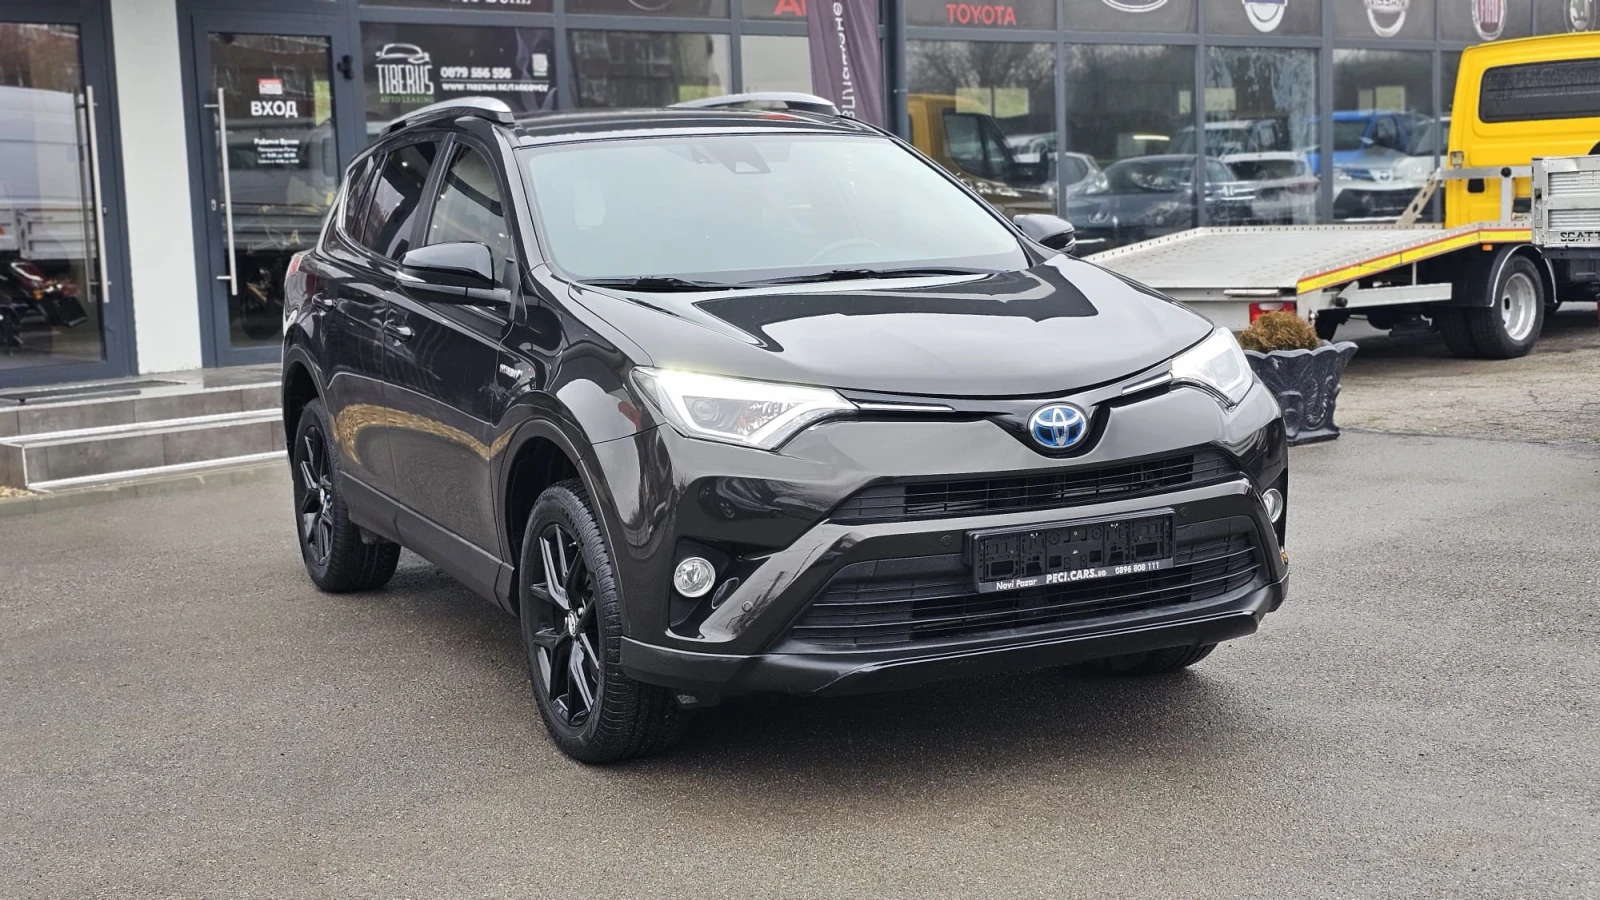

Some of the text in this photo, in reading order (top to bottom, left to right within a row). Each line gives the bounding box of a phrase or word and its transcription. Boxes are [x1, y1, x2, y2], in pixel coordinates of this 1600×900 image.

[946, 3, 1017, 26] TOYOTA
[375, 64, 434, 95] TIBERUS
[440, 66, 469, 79] 0879
[250, 101, 298, 118] ВХОД
[380, 95, 435, 104] AUTO LEASING
[996, 561, 1160, 591] Novi Pazar PECI.CARS.BG 0896 808 111
